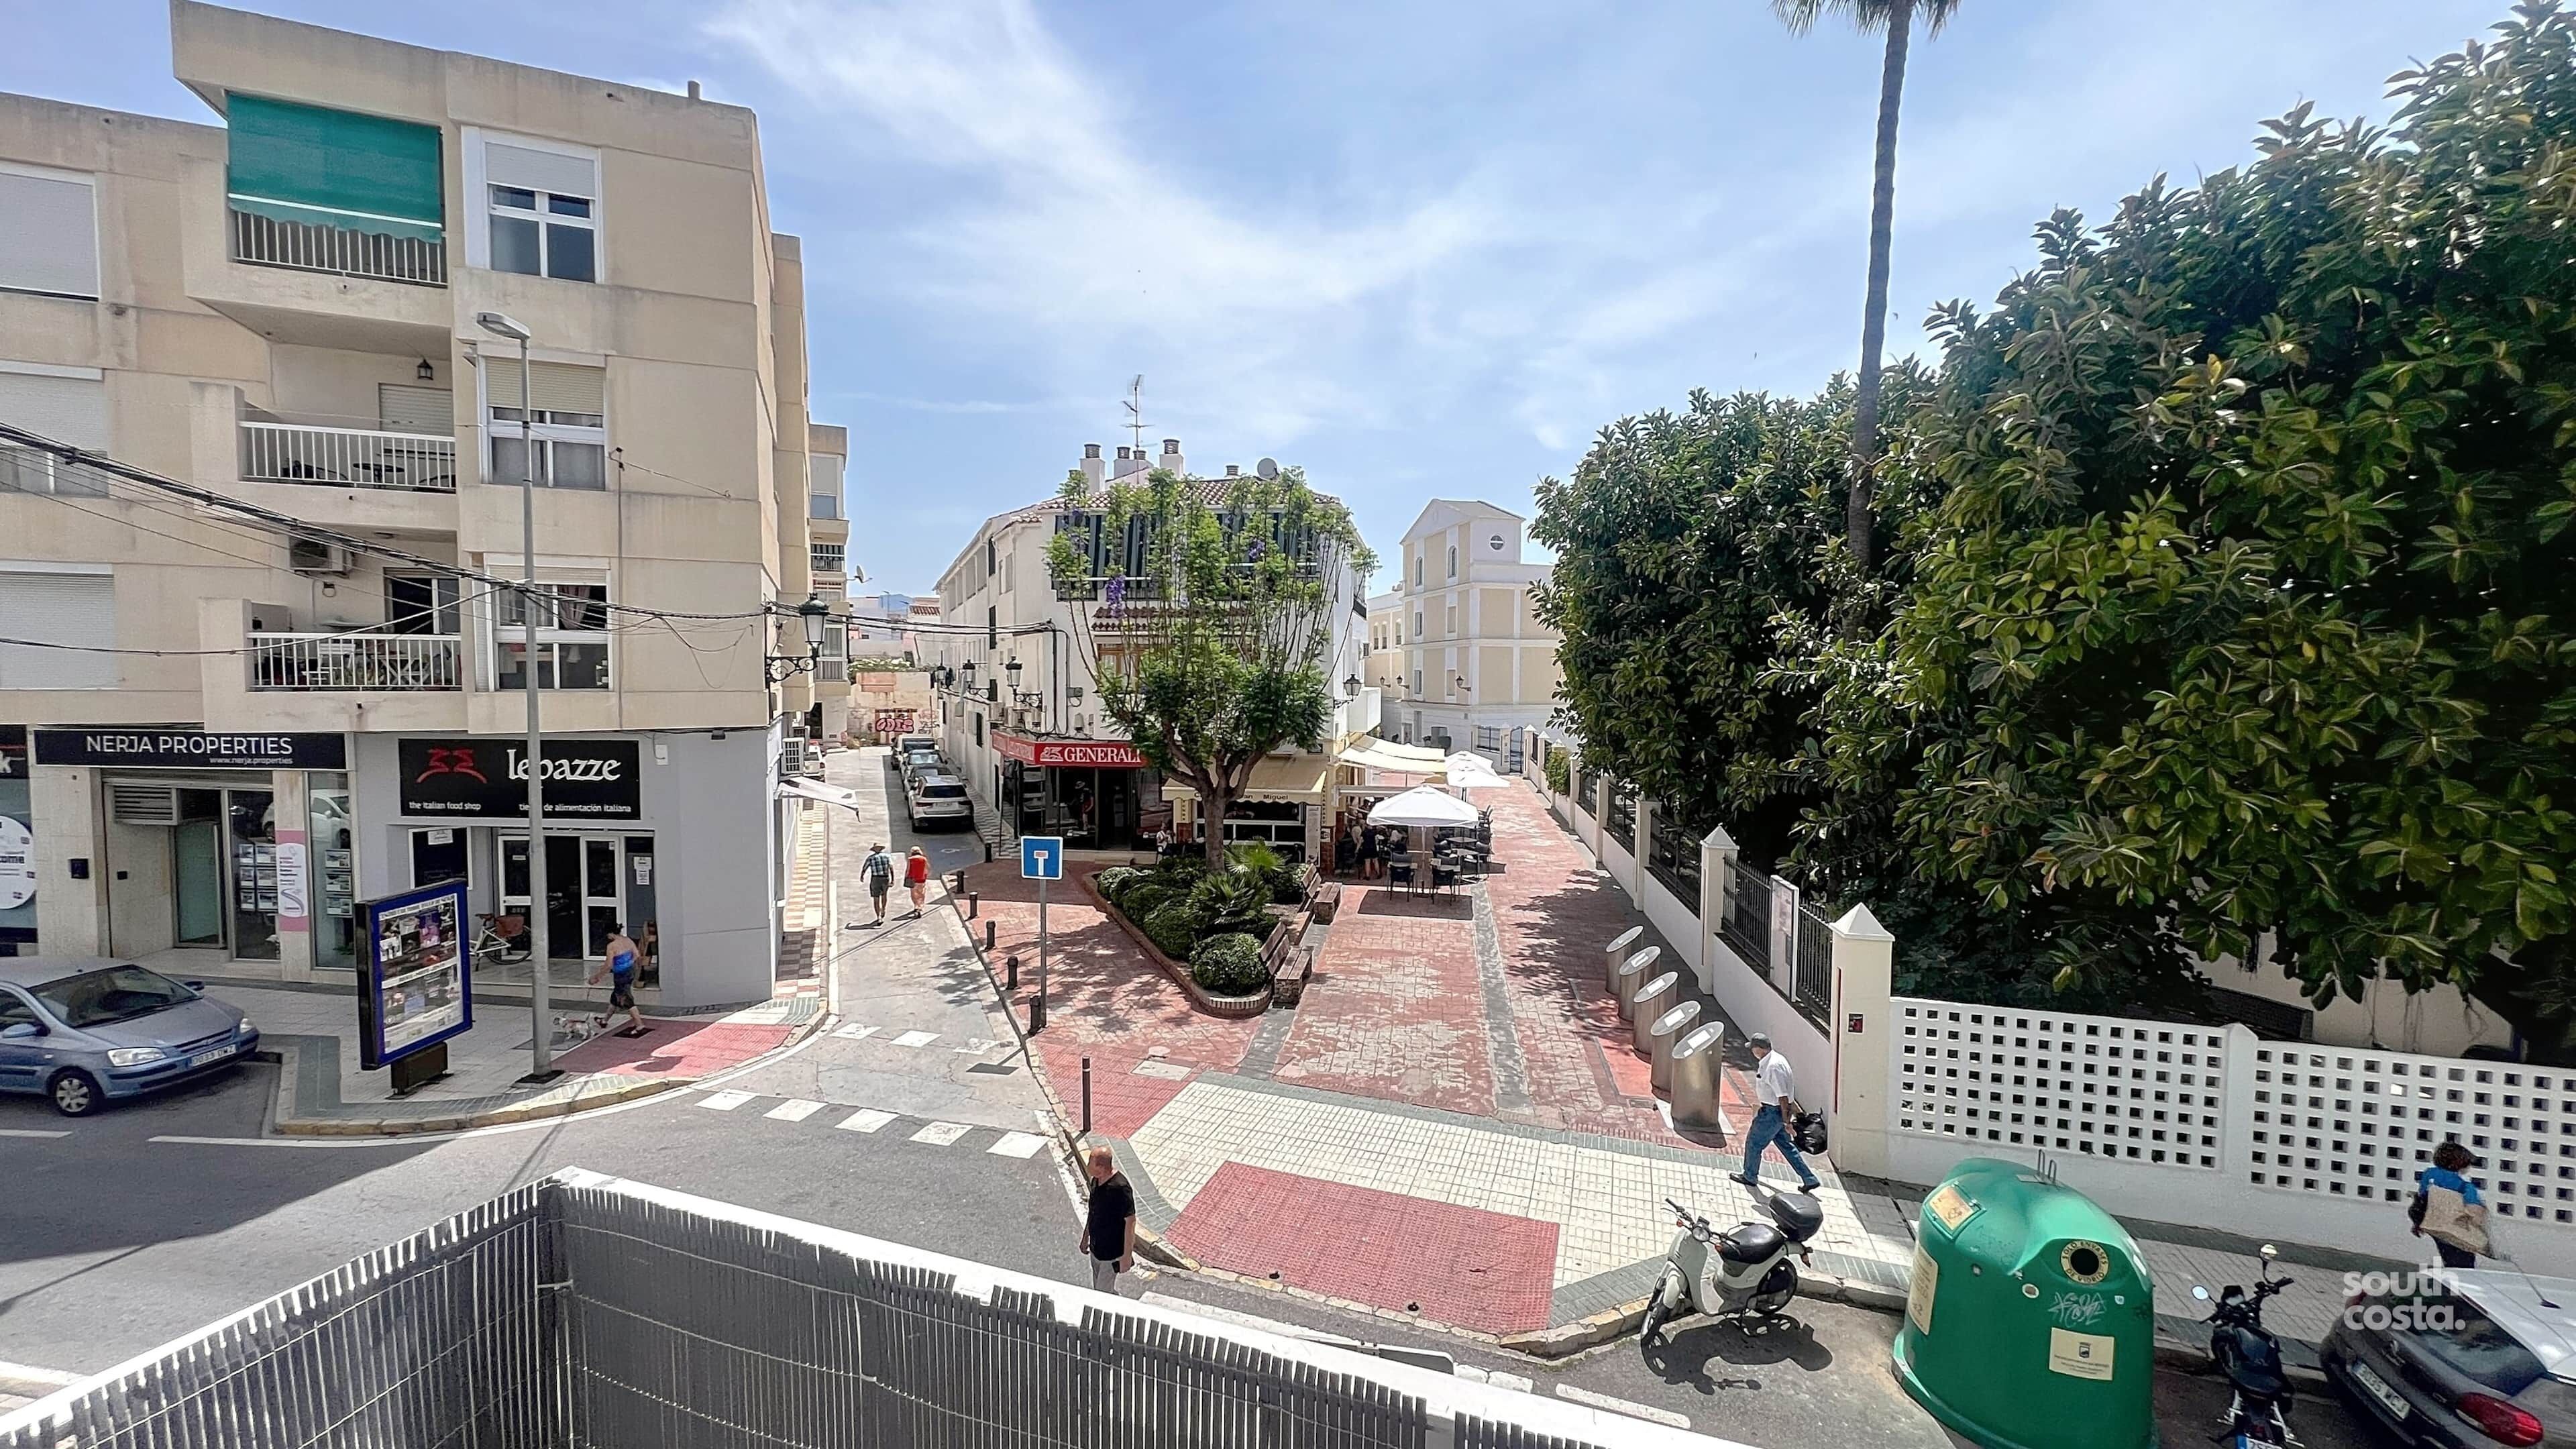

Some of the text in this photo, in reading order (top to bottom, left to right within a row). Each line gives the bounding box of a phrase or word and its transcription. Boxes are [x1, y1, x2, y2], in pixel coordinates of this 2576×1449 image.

[86, 735, 292, 754] NERJA PROPERTIES
[209, 757, 293, 765] www.nerja.properties
[1064, 746, 1141, 763] GENERALI
[409, 801, 421, 809] the
[447, 802, 463, 810] food
[464, 802, 482, 811] shop
